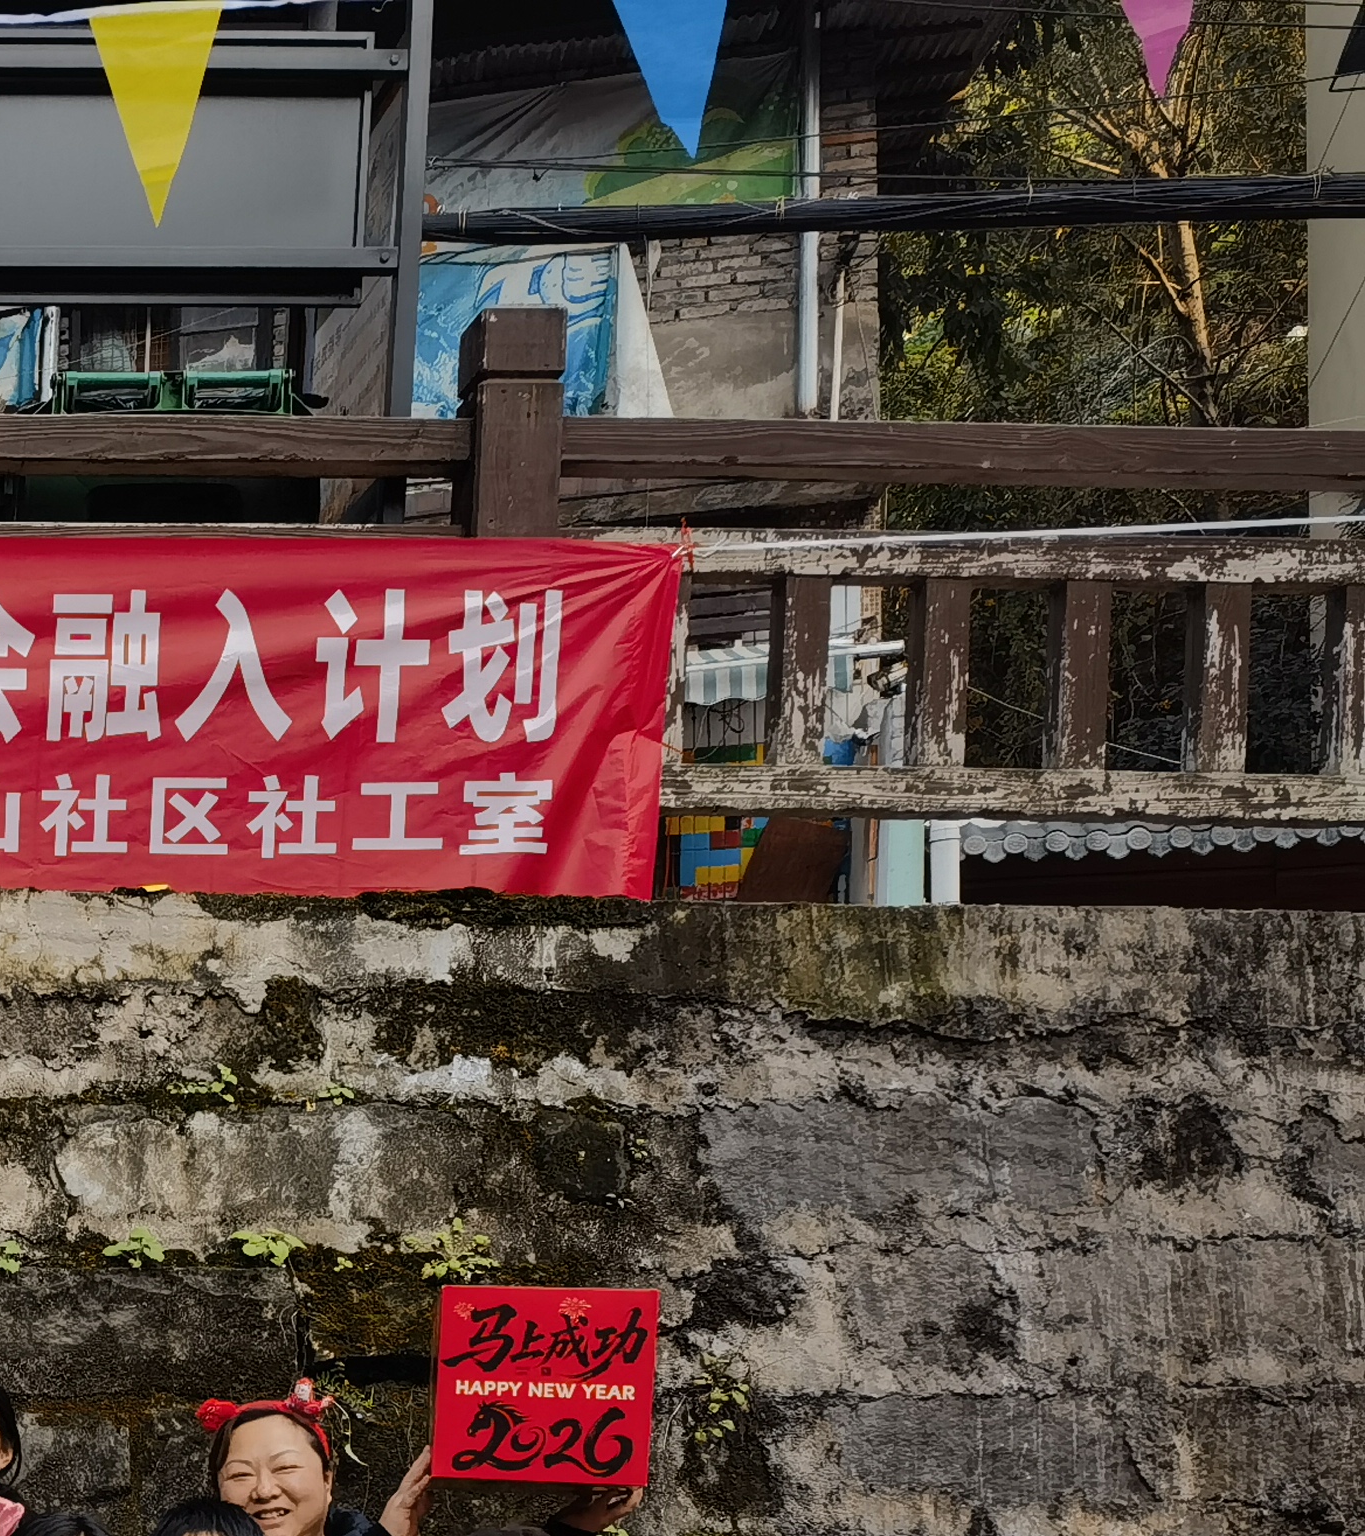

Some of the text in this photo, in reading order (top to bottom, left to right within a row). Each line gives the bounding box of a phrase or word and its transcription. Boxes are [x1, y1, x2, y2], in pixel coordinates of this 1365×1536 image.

[440, 1303, 649, 1383] 马上成功
[455, 1379, 636, 1401] HAPPY NEW YEAR
[451, 1400, 635, 1479] 2026
